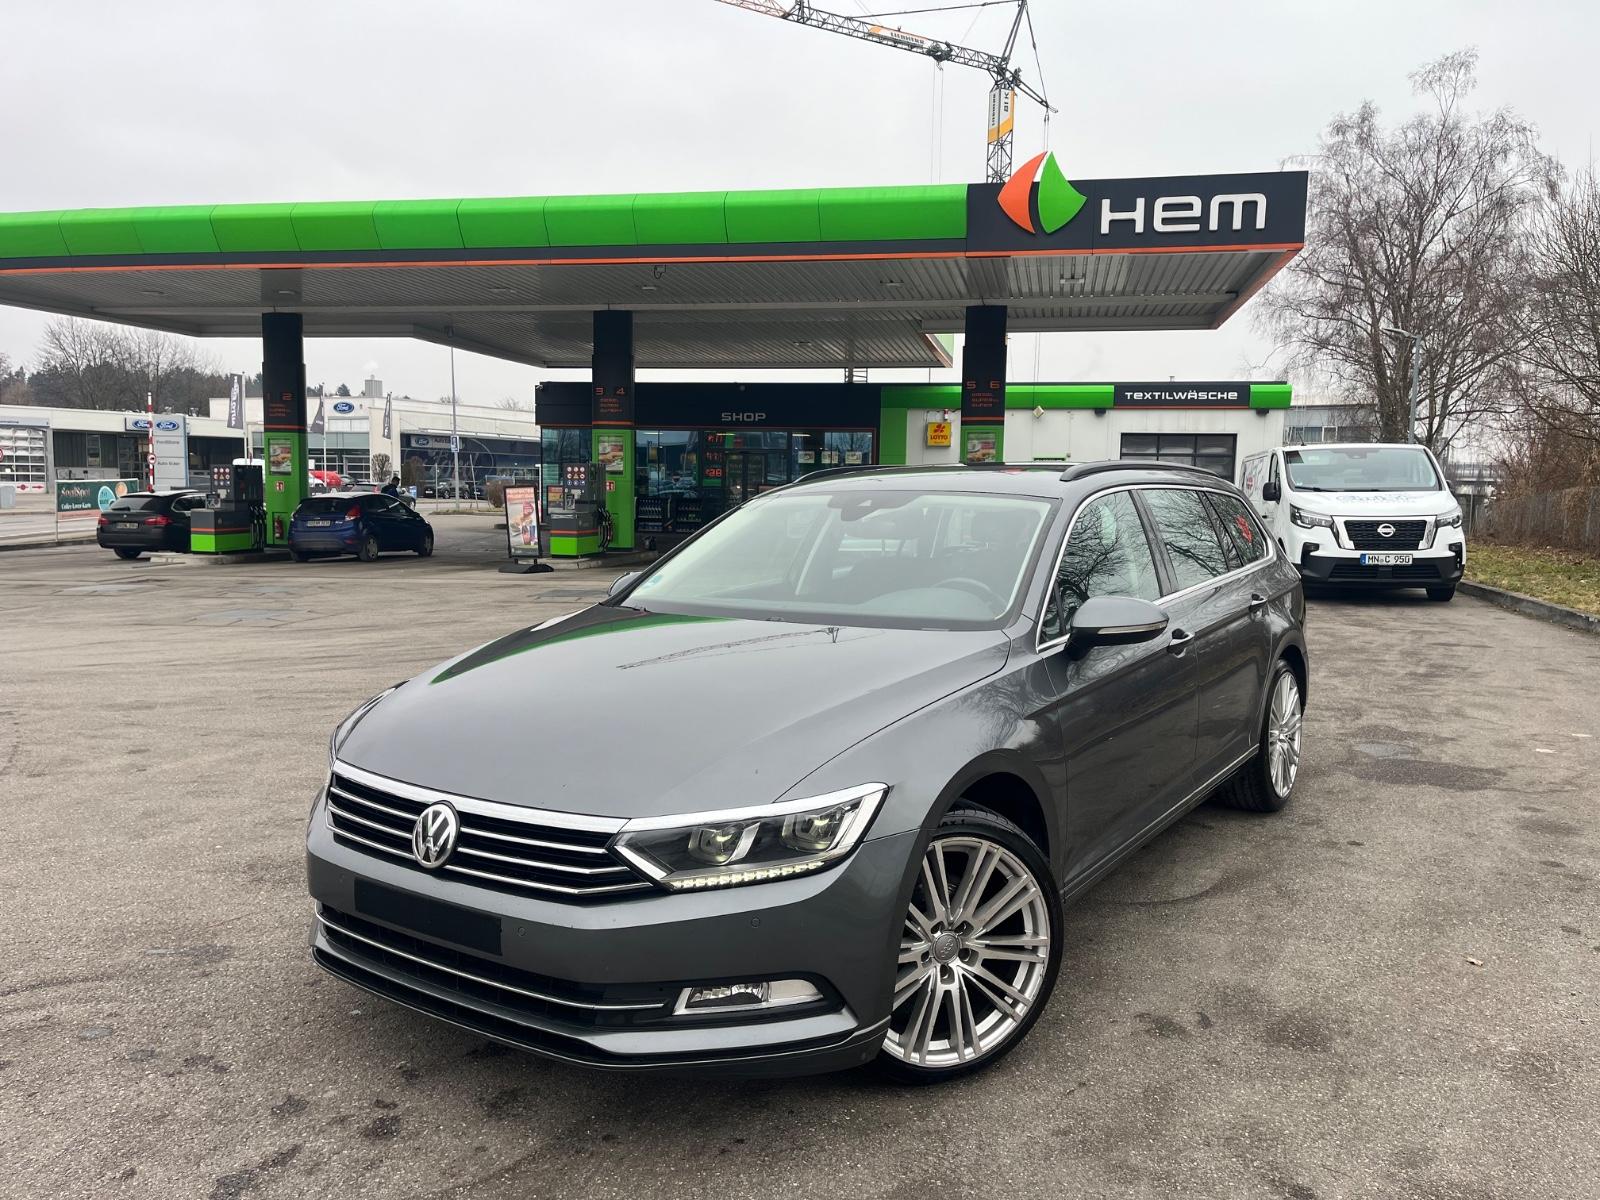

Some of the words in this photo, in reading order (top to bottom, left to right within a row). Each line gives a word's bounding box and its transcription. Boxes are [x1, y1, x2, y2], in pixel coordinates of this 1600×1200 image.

[966, 381, 976, 389] 5
[990, 381, 1000, 389] 6
[721, 412, 767, 422] SHOP
[1368, 555, 1379, 563] MN
[1385, 555, 1390, 563] C
[1394, 555, 1410, 563] 950
